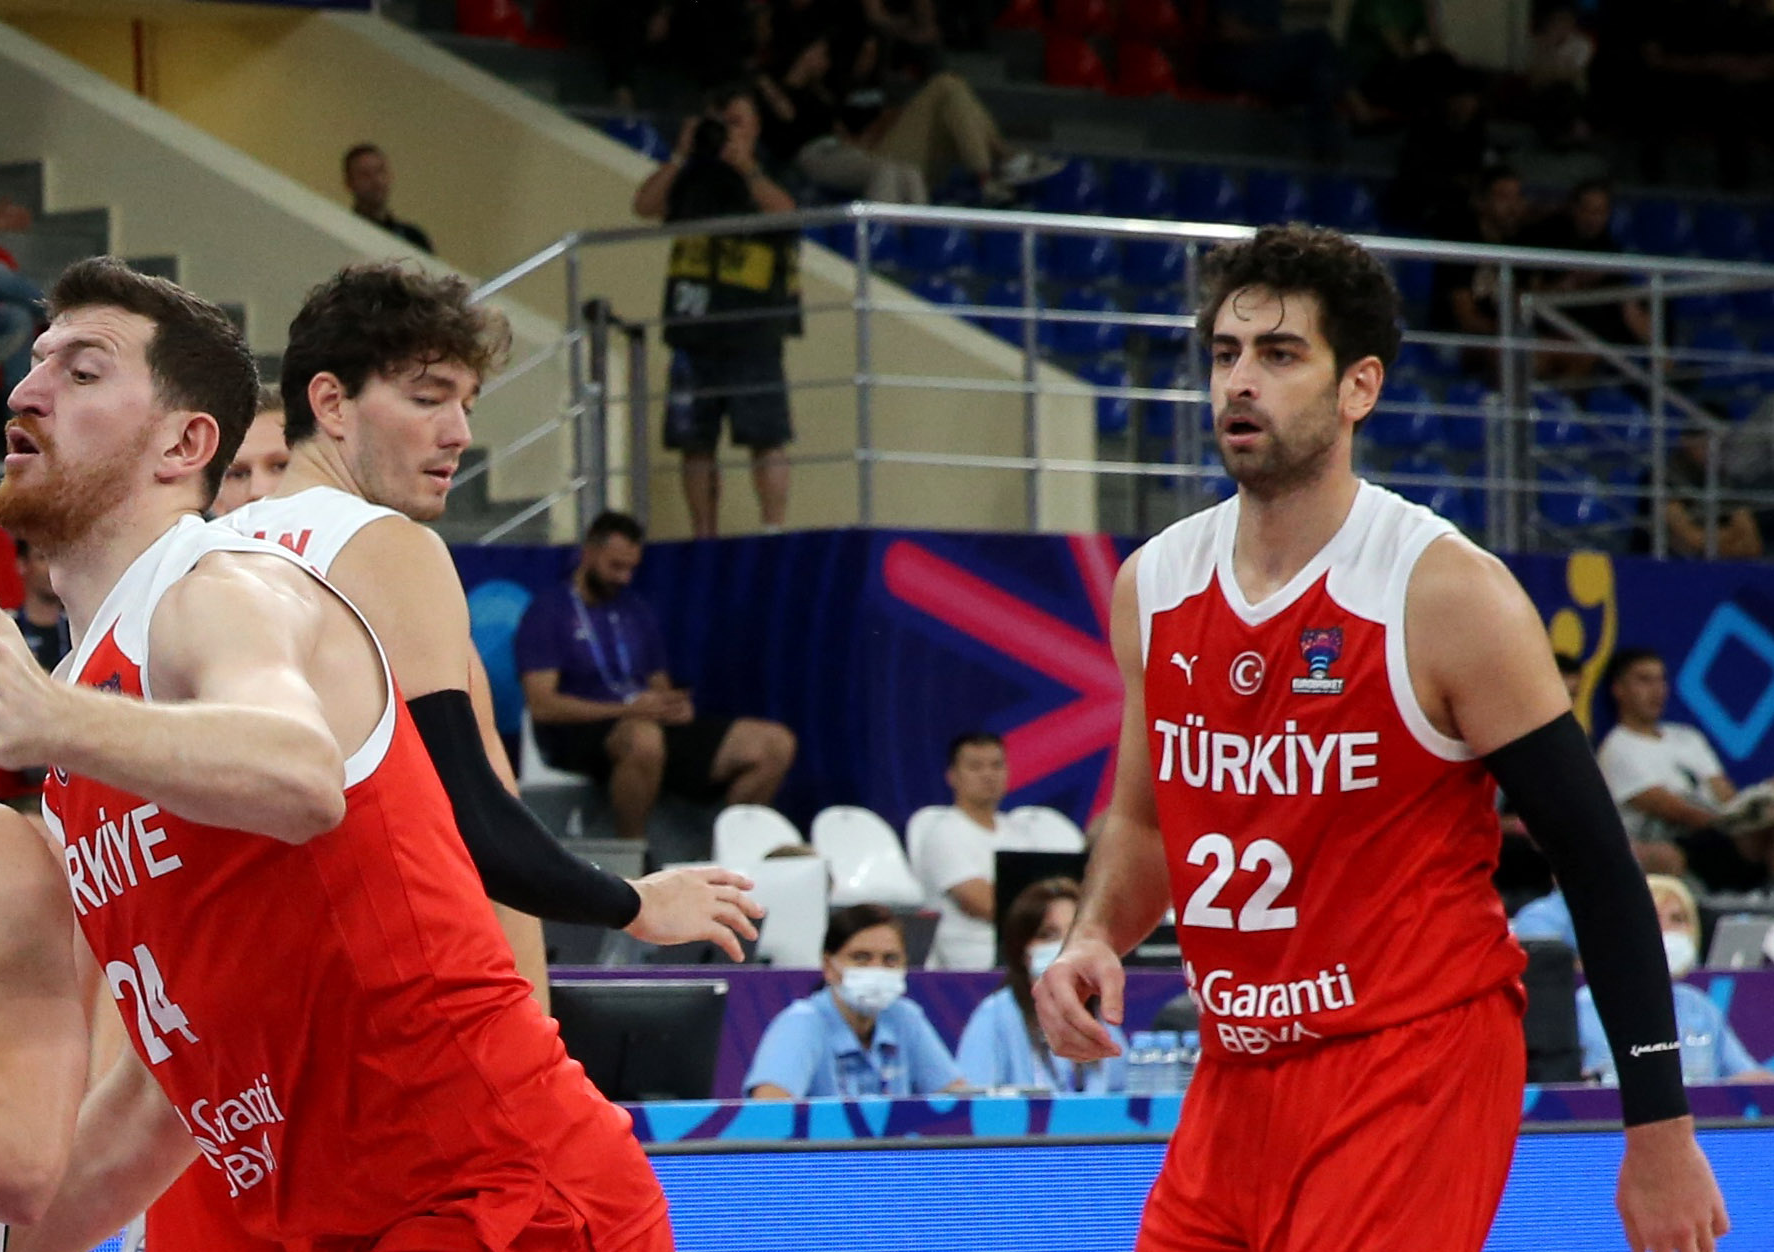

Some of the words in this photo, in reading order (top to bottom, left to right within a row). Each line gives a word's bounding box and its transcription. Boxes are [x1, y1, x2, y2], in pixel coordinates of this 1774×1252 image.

[1154, 713, 1380, 796] TÜRKİYE
[64, 801, 184, 916] RKİYE
[1182, 833, 1299, 932] 22
[105, 943, 201, 1065] 24
[1201, 963, 1357, 1018] Garanti
[1216, 1021, 1324, 1055] BBVA
